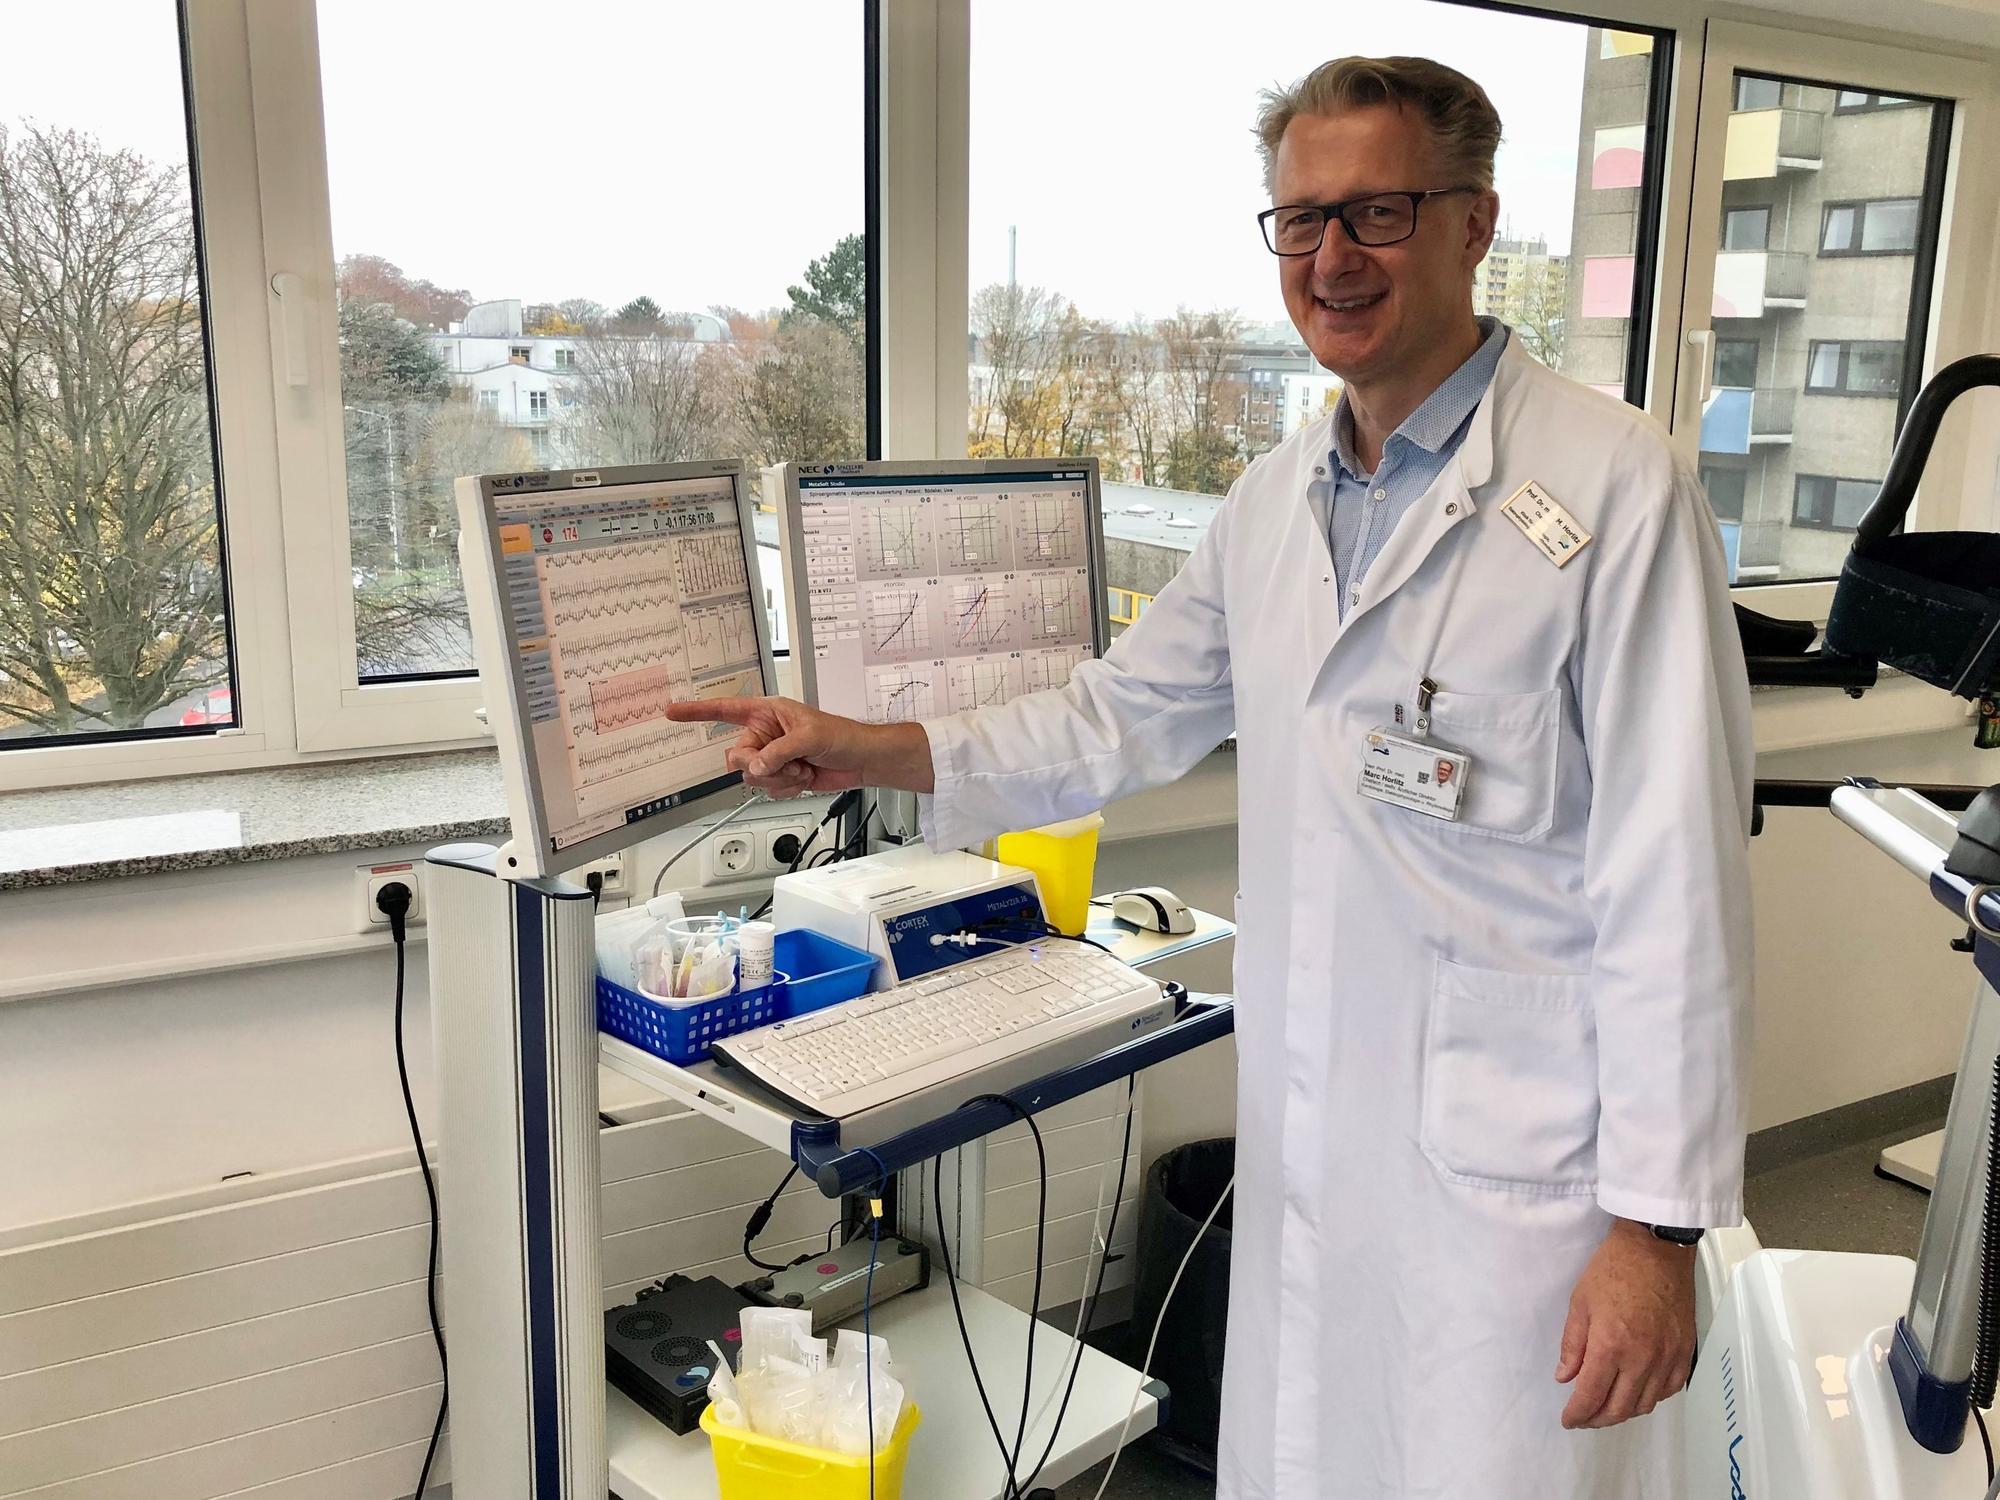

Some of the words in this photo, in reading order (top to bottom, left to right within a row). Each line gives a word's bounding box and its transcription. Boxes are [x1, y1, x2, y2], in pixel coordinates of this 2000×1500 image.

[799, 466, 820, 474] NEC
[491, 479, 512, 488] NEC
[851, 489, 876, 497] Allgemeine
[1526, 488, 1537, 500] Prof.
[678, 514, 697, 527] 17:56
[562, 526, 578, 541] 174
[1562, 525, 1581, 544] Horlitz
[1364, 769, 1380, 780] Marc
[1382, 775, 1405, 786] Horlitz
[895, 915, 928, 931] CORTEX
